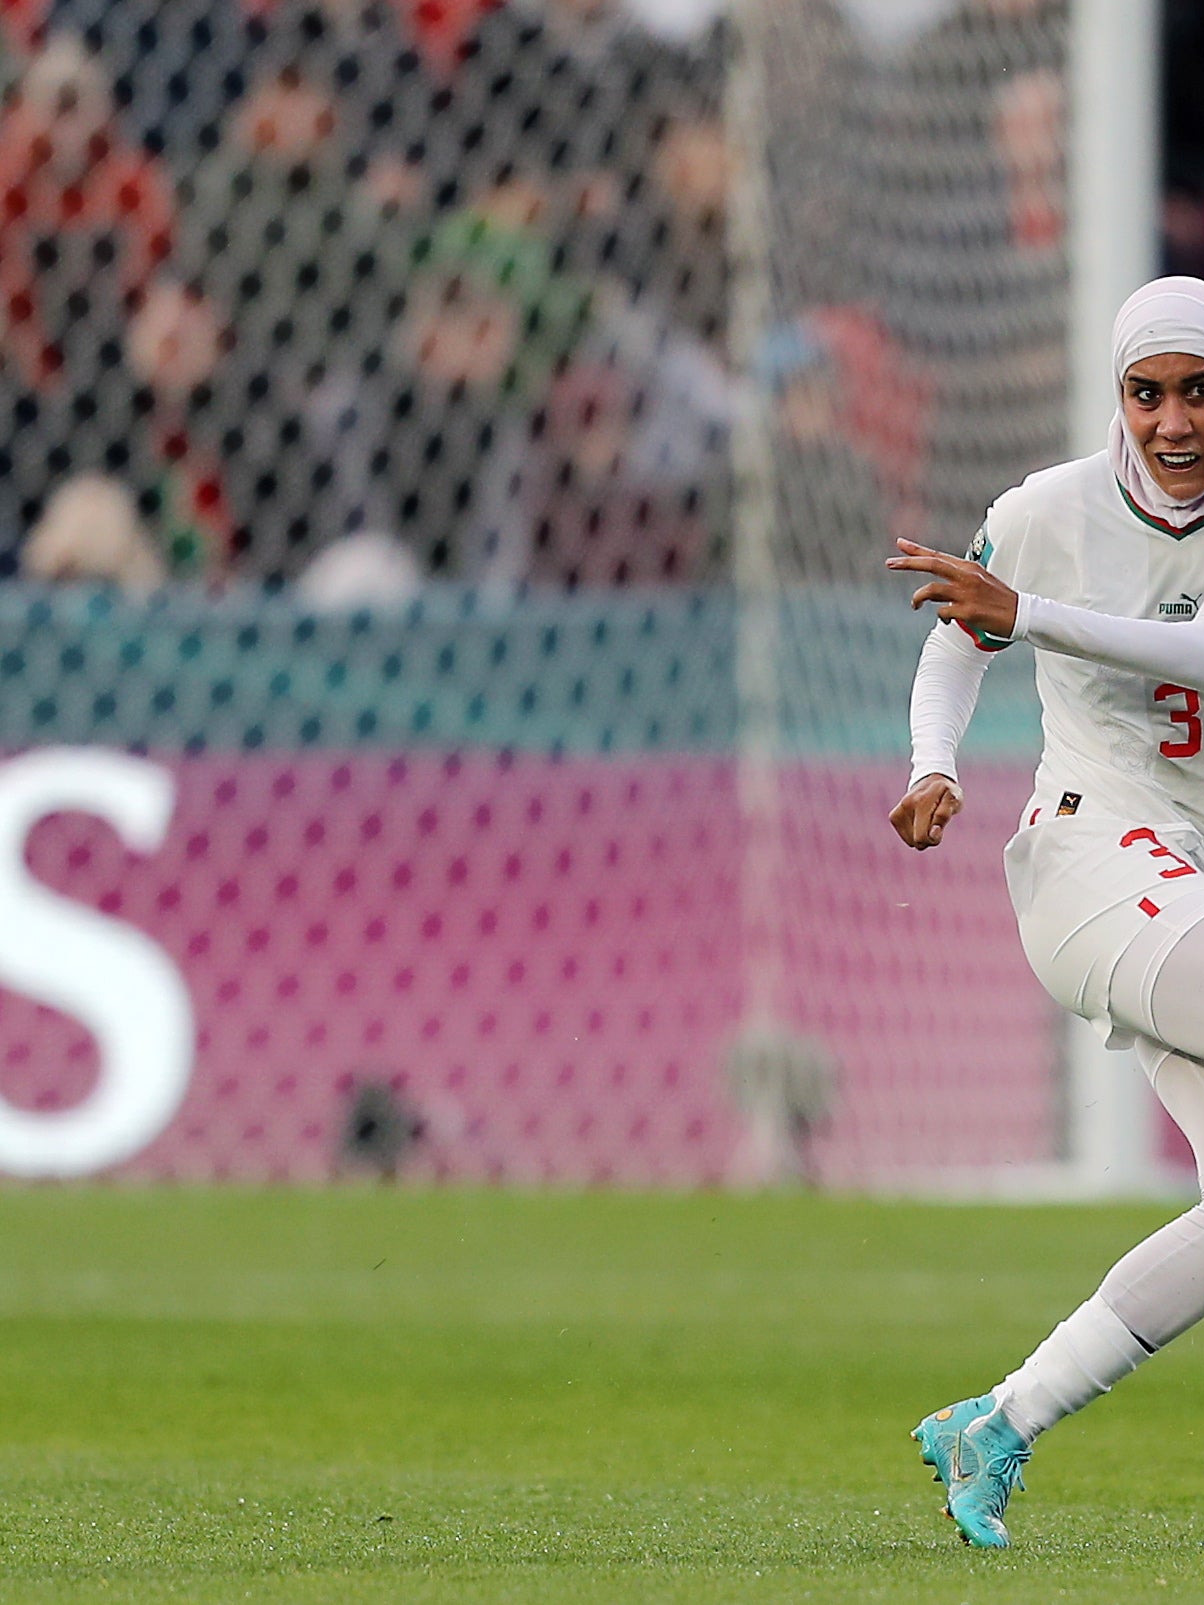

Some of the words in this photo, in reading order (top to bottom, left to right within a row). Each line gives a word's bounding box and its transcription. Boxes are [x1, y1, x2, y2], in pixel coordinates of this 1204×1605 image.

[1159, 603, 1193, 615] PUMA
[1154, 683, 1202, 758] 3
[1119, 828, 1197, 878] 3
[0, 744, 196, 1178] S
